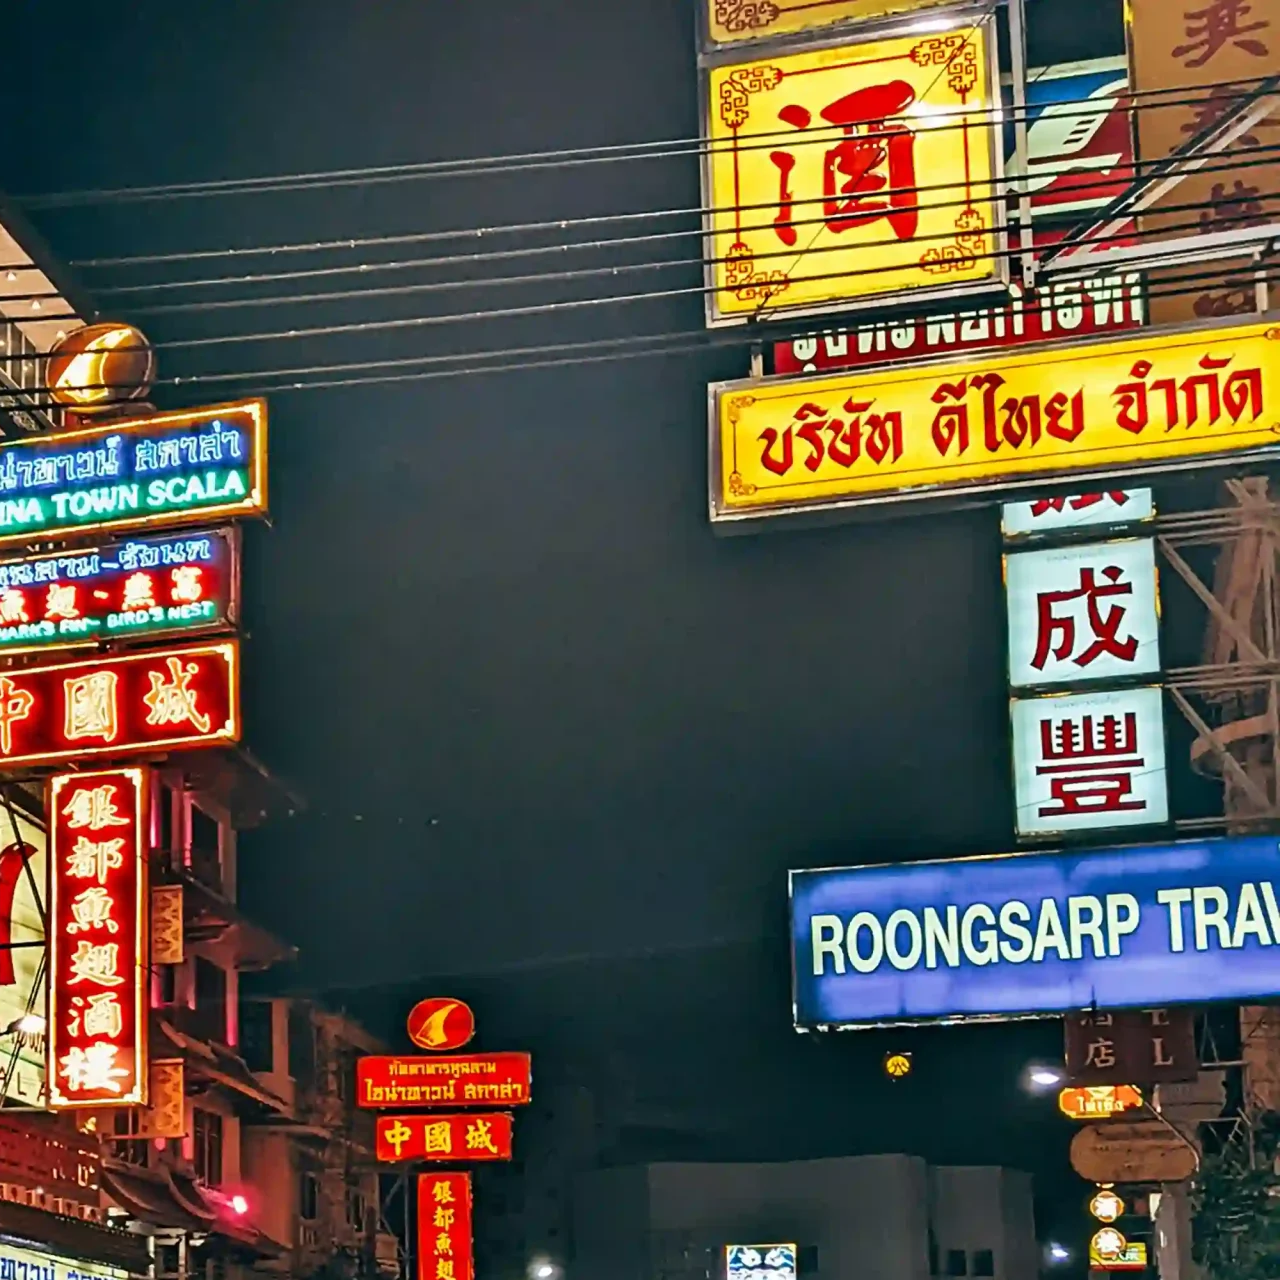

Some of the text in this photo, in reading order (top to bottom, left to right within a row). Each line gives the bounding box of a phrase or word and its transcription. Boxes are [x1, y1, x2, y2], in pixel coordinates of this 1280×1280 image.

[759, 352, 1263, 476] บริษัท ดีไทย จำกัด
[51, 484, 142, 520] TOWN
[147, 470, 246, 506] SCALA
[168, 601, 215, 621] NEST
[1030, 489, 1147, 817] 成豐
[60, 785, 129, 1092] 銀都魚翅酒樓
[811, 892, 1139, 976] ROONGSARP
[384, 1119, 498, 1156] 中國城
